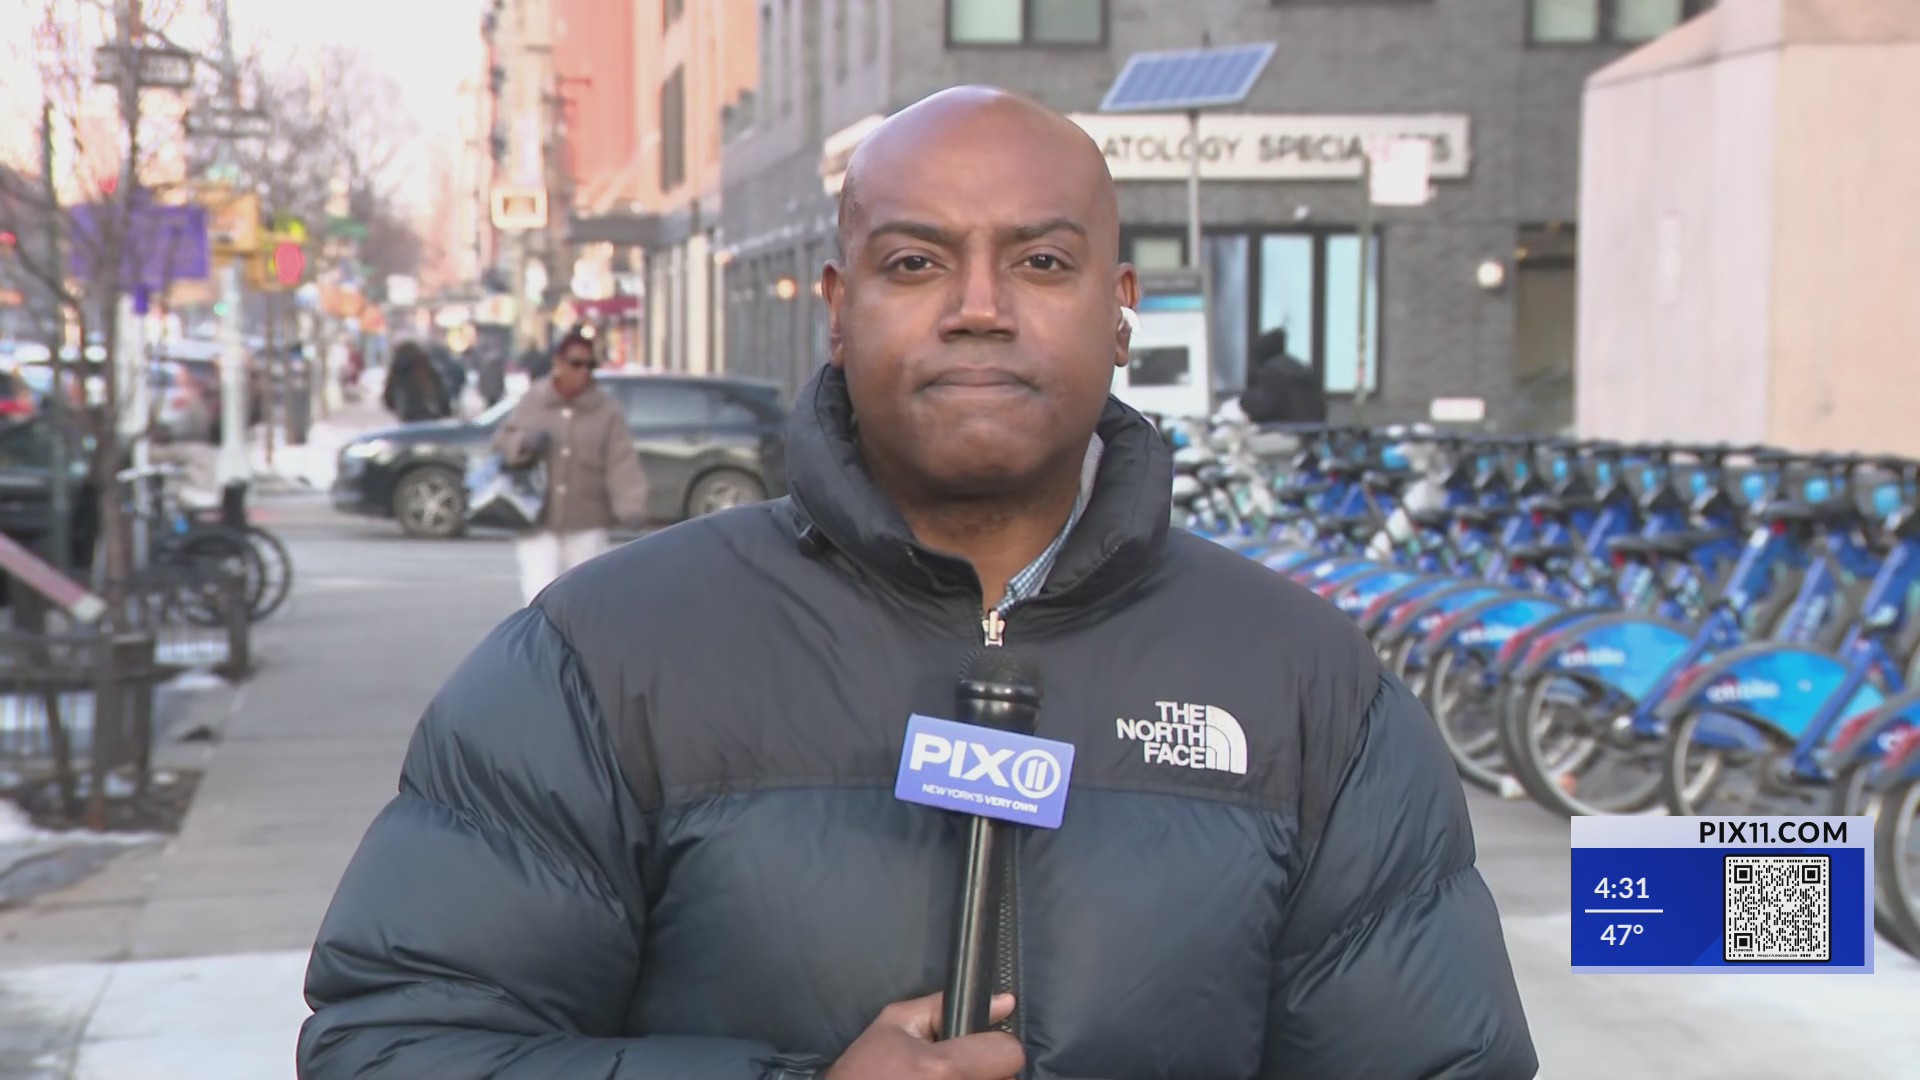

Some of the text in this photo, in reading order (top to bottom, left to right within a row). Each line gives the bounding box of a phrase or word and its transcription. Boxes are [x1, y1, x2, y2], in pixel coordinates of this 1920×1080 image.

[1258, 133, 1452, 163] SPECIAS
[1155, 701, 1205, 726] THE
[1116, 718, 1205, 747] NORTH
[1144, 742, 1205, 769] FACE
[922, 783, 947, 796] NEW
[985, 795, 1014, 808] VERY
[1012, 803, 1038, 813] OWN
